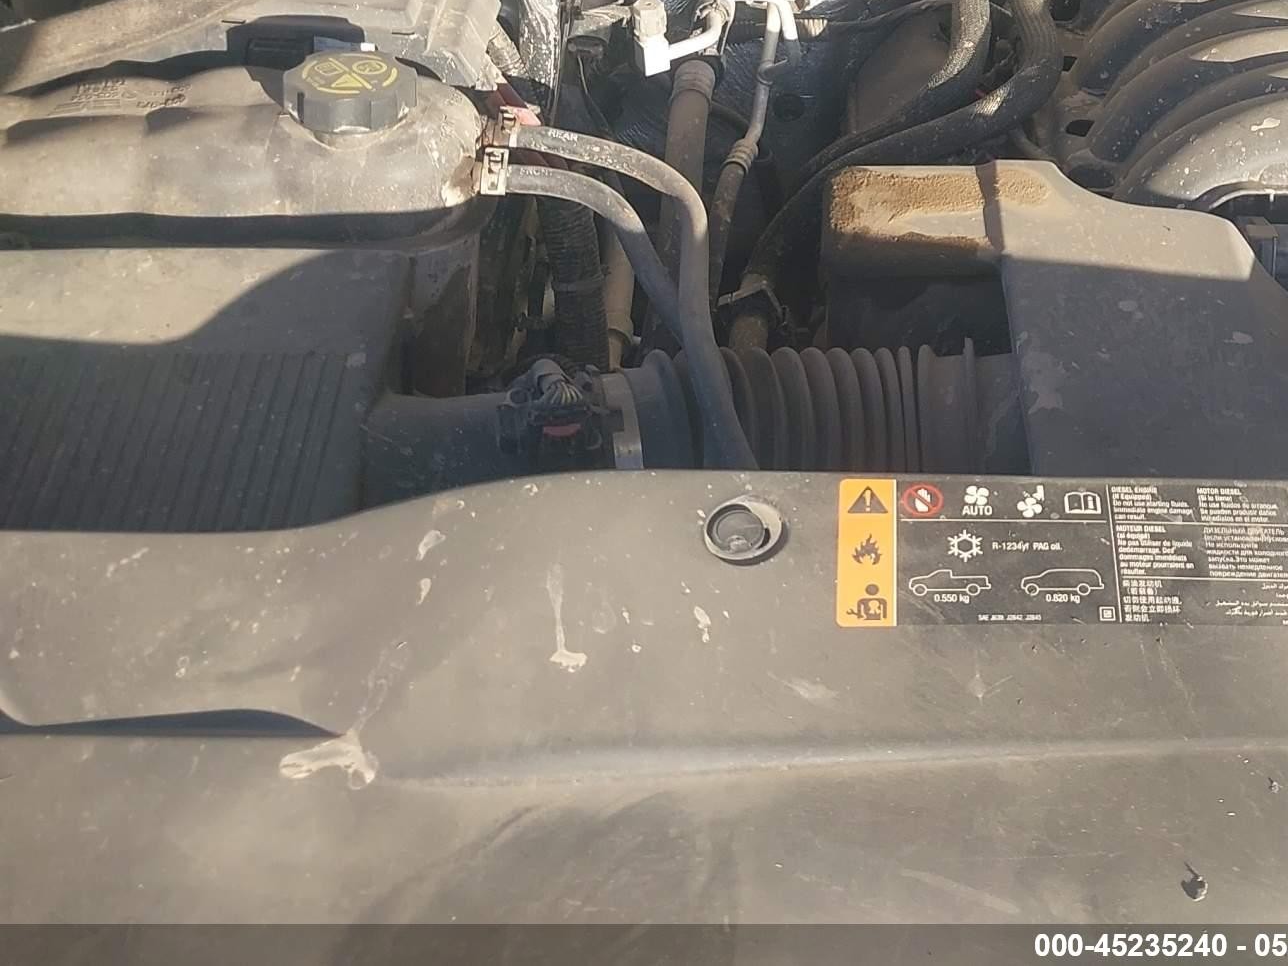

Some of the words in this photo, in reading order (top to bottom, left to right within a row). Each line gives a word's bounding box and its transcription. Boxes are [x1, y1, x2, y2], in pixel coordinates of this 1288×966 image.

[548, 129, 578, 142] REAR
[962, 506, 993, 516] AUTO
[992, 541, 1030, 551] R-1234yf
[1033, 542, 1050, 551] PAG
[1050, 542, 1063, 551] oil.
[934, 594, 957, 603] 0.550
[959, 594, 970, 603] kg
[1046, 594, 1069, 603] 0.820
[1070, 594, 1080, 604] kg
